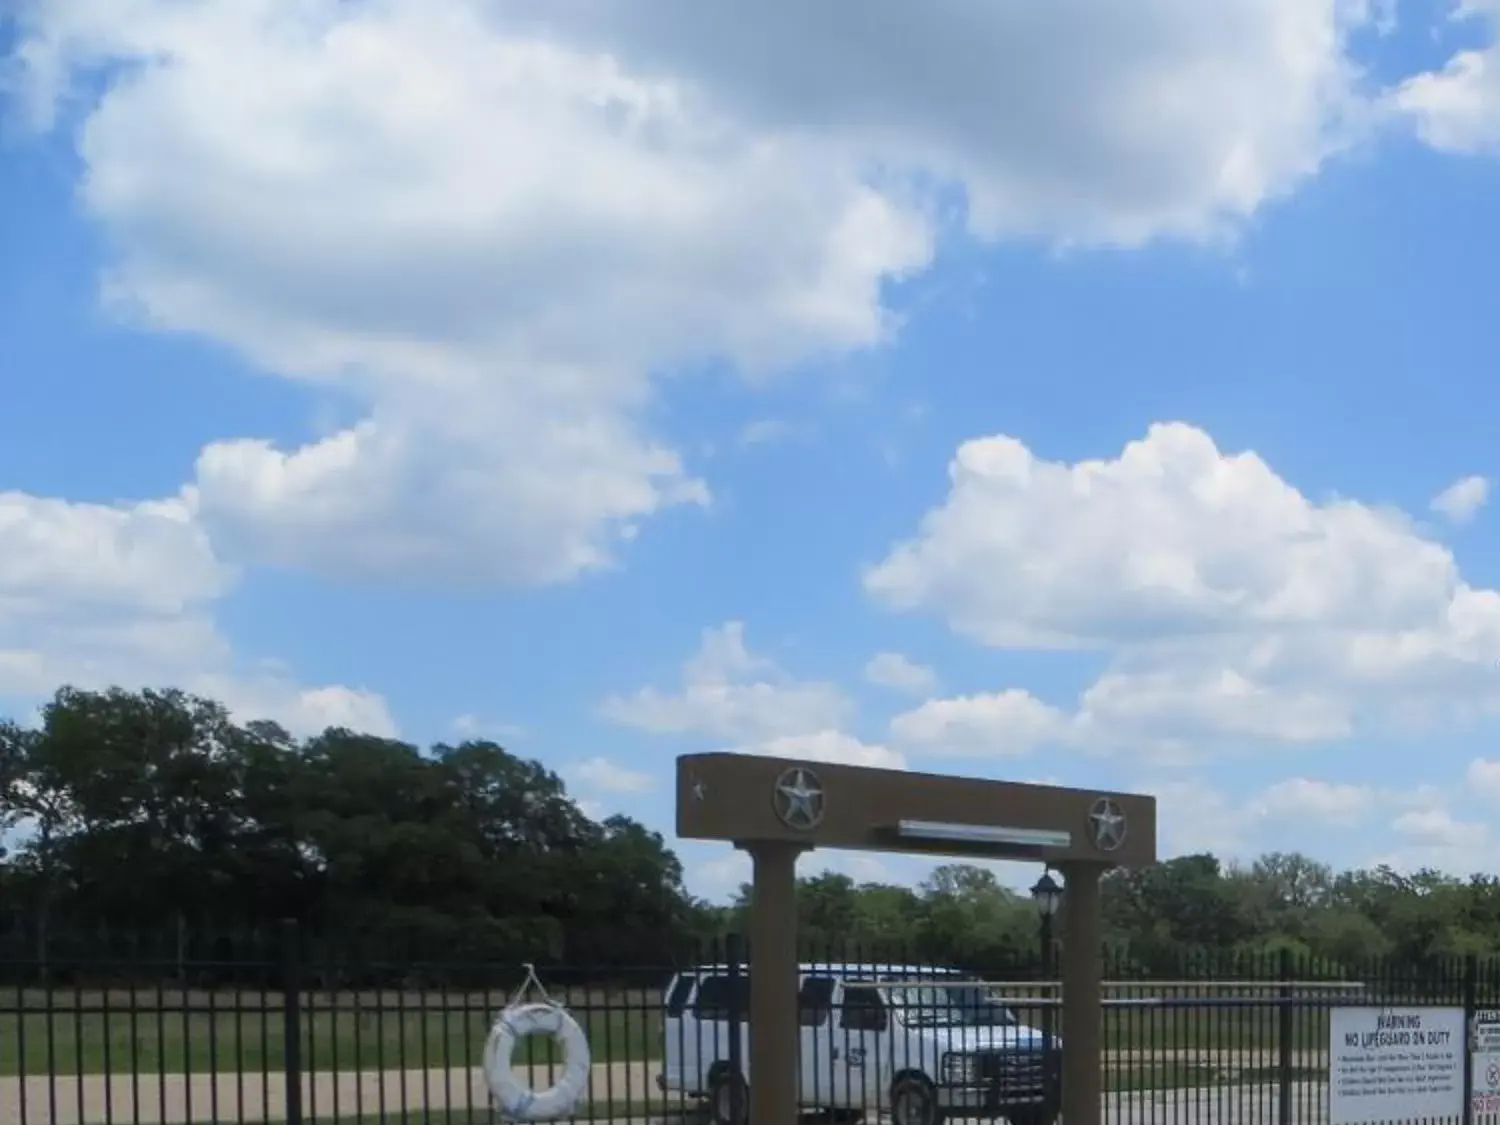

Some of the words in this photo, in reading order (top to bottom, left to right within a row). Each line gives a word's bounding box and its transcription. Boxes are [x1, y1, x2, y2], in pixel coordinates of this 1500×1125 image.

[1377, 1015, 1420, 1028] WARNING
[1345, 1031, 1359, 1046] NO
[1361, 1030, 1410, 1046] LIFEGUARD
[1412, 1030, 1425, 1045] ON
[1427, 1030, 1450, 1045] DUTY
